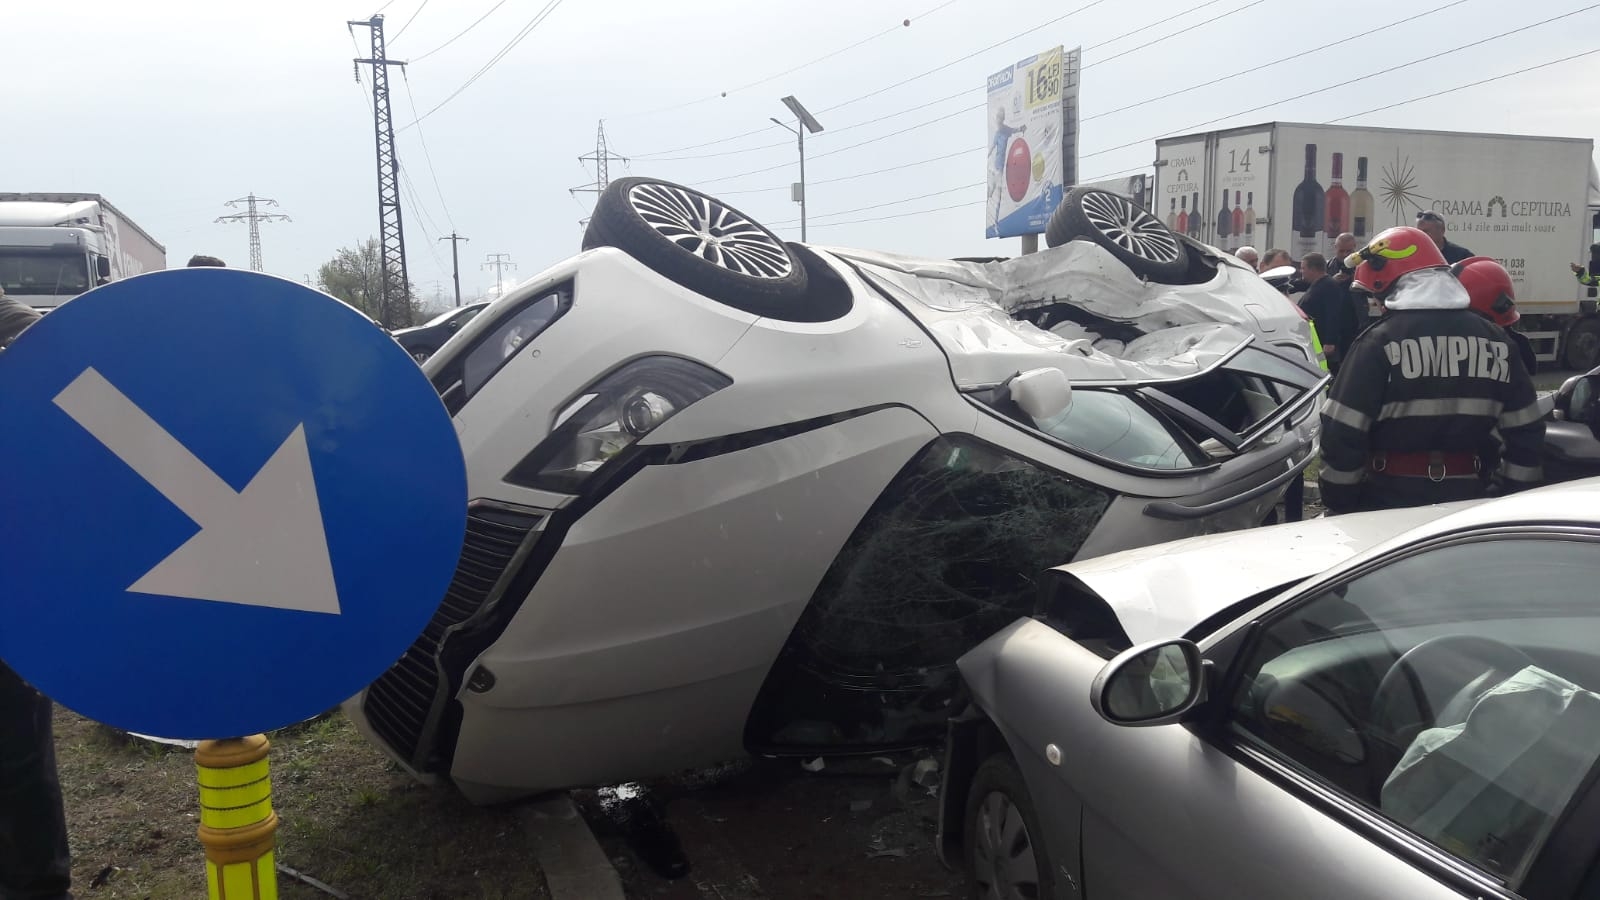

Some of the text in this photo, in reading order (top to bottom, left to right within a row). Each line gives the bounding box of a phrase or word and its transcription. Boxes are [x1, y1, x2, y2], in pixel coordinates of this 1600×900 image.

[1028, 63, 1047, 104] 16
[1048, 78, 1059, 97] 90
[1170, 156, 1196, 168] CRAMA
[1228, 148, 1251, 173] 14
[1167, 182, 1199, 193] CEPTURA
[1432, 200, 1571, 217] CRAMA CEPTURA
[1447, 222, 1556, 232] Cu 14 zile mai mult soare
[1511, 258, 1525, 268] 038
[1384, 336, 1510, 383] POMPIER
